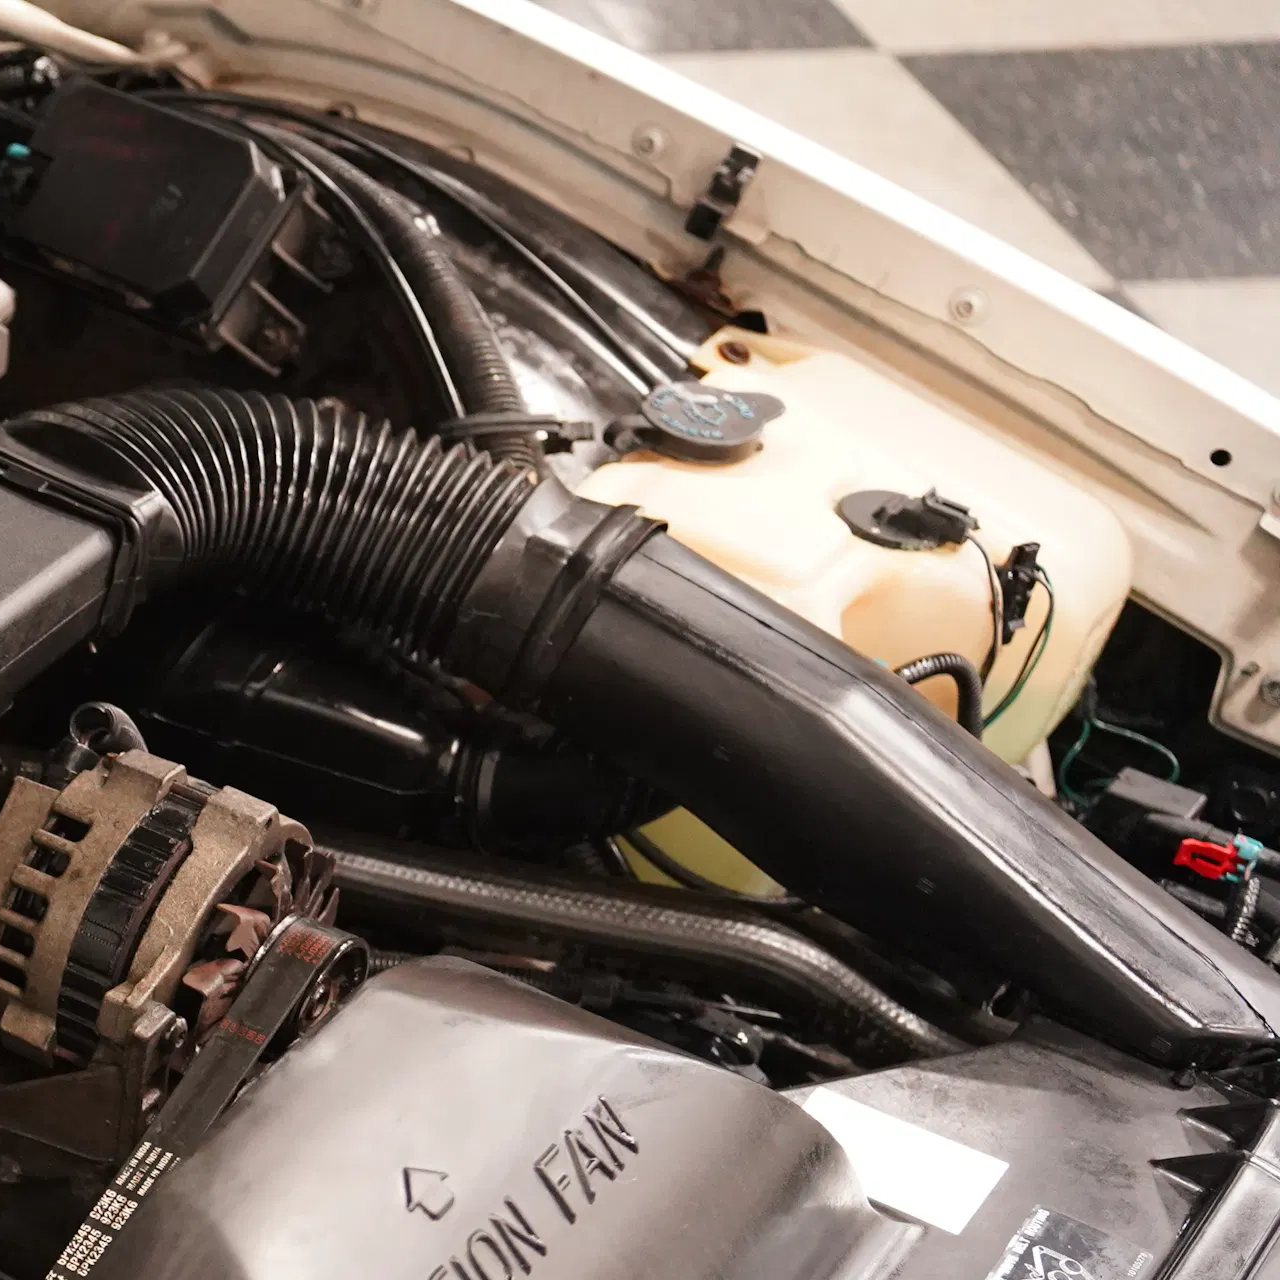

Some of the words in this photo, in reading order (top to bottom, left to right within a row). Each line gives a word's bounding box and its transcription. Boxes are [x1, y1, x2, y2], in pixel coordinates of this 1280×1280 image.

[77, 1234, 113, 1277] 6PK2345
[110, 1200, 139, 1231] 923K6
[137, 1177, 155, 1197] MADE
[155, 1151, 174, 1171] INDIA
[533, 1094, 641, 1224] FAN
[66, 1228, 102, 1272] 6PK2345
[99, 1194, 128, 1225] 923K6
